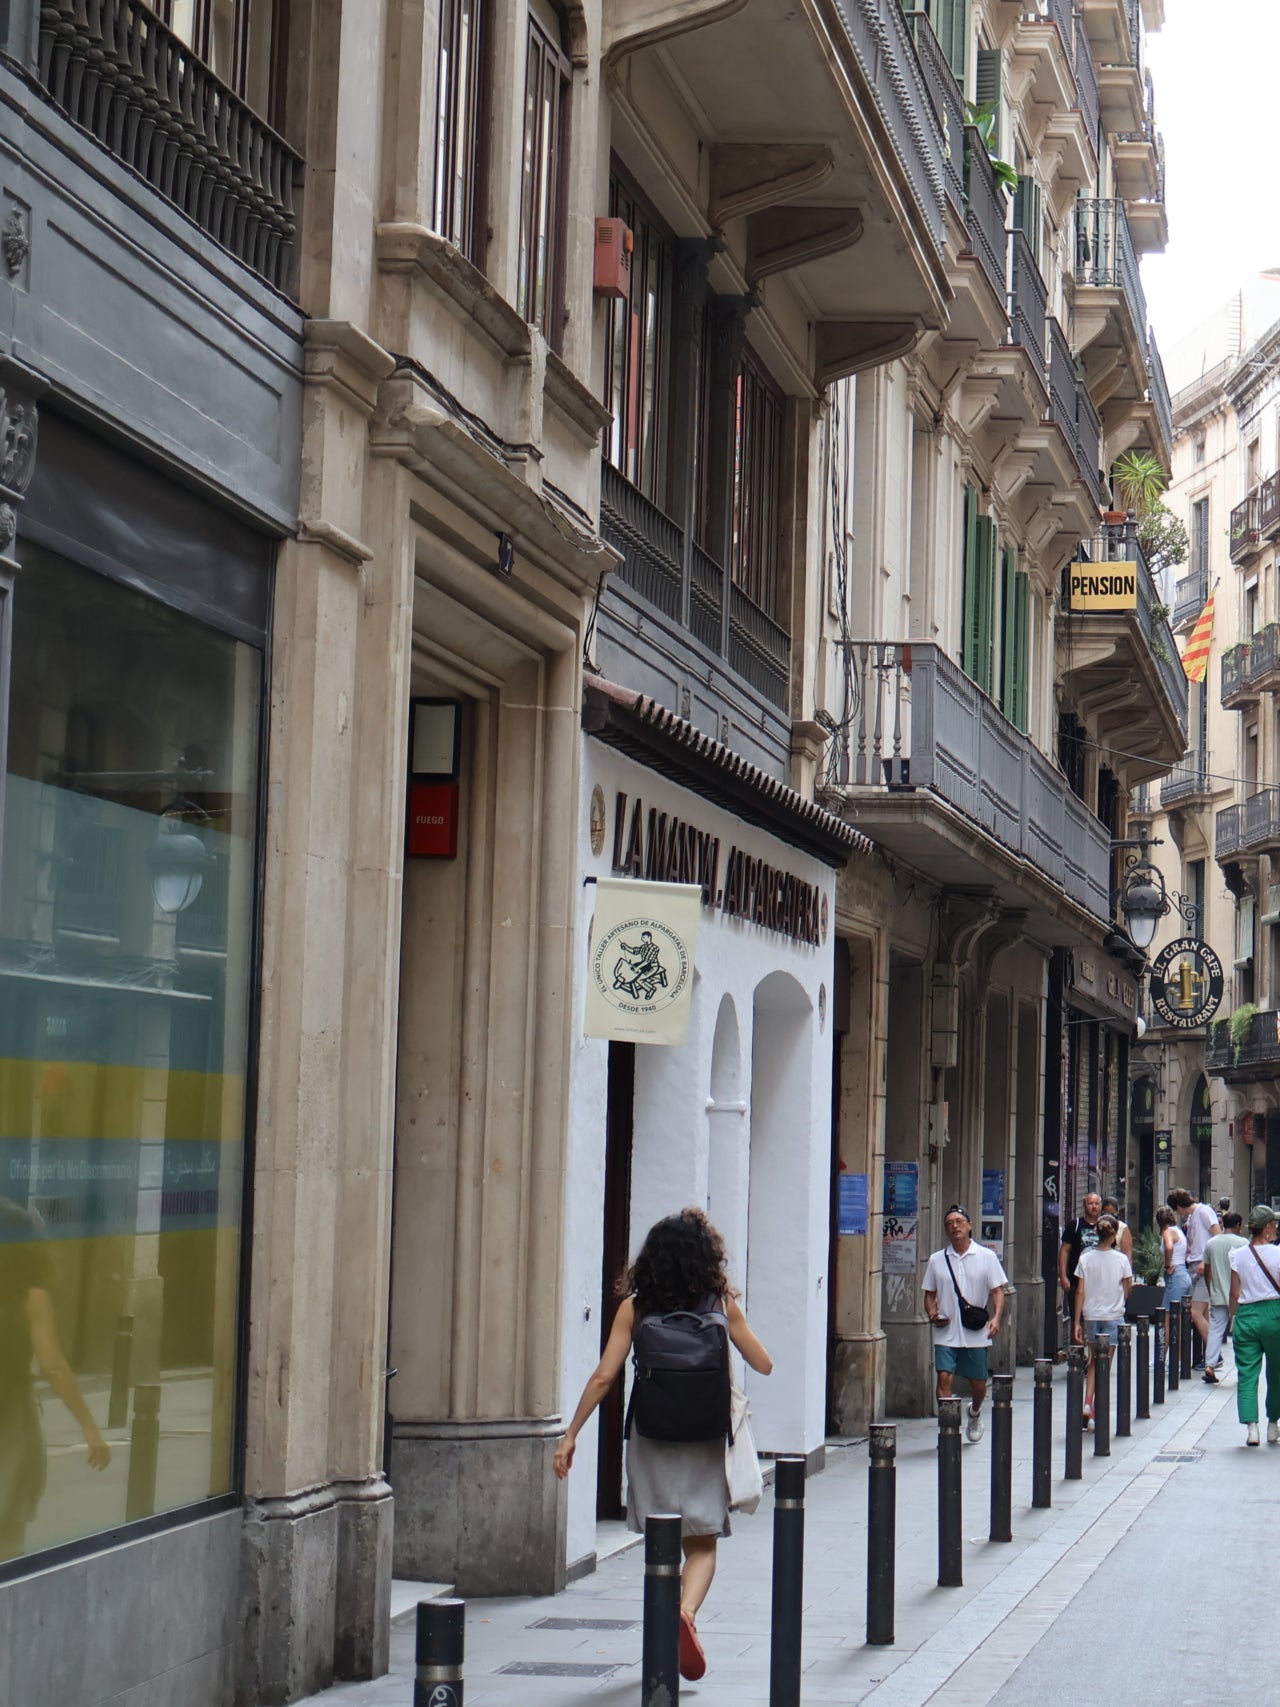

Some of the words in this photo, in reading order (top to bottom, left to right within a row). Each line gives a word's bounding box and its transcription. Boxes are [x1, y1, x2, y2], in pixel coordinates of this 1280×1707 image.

[1072, 576, 1134, 596] PENSION
[416, 816, 444, 825] FUEGO
[612, 792, 644, 880] LA
[607, 920, 639, 940] ARTESANO
[650, 920, 683, 950] ALPARGATAS
[595, 939, 609, 961] TALLER
[680, 950, 687, 960] DE
[1153, 961, 1166, 978] EL
[1163, 940, 1199, 959] GRAN
[1200, 947, 1221, 978] CAFE
[600, 984, 608, 993] EL
[669, 961, 687, 998] BARCELONA
[618, 1002, 639, 1013] DESDE
[641, 1004, 656, 1013] 1940
[1156, 995, 1218, 1028] RESTAURANT
